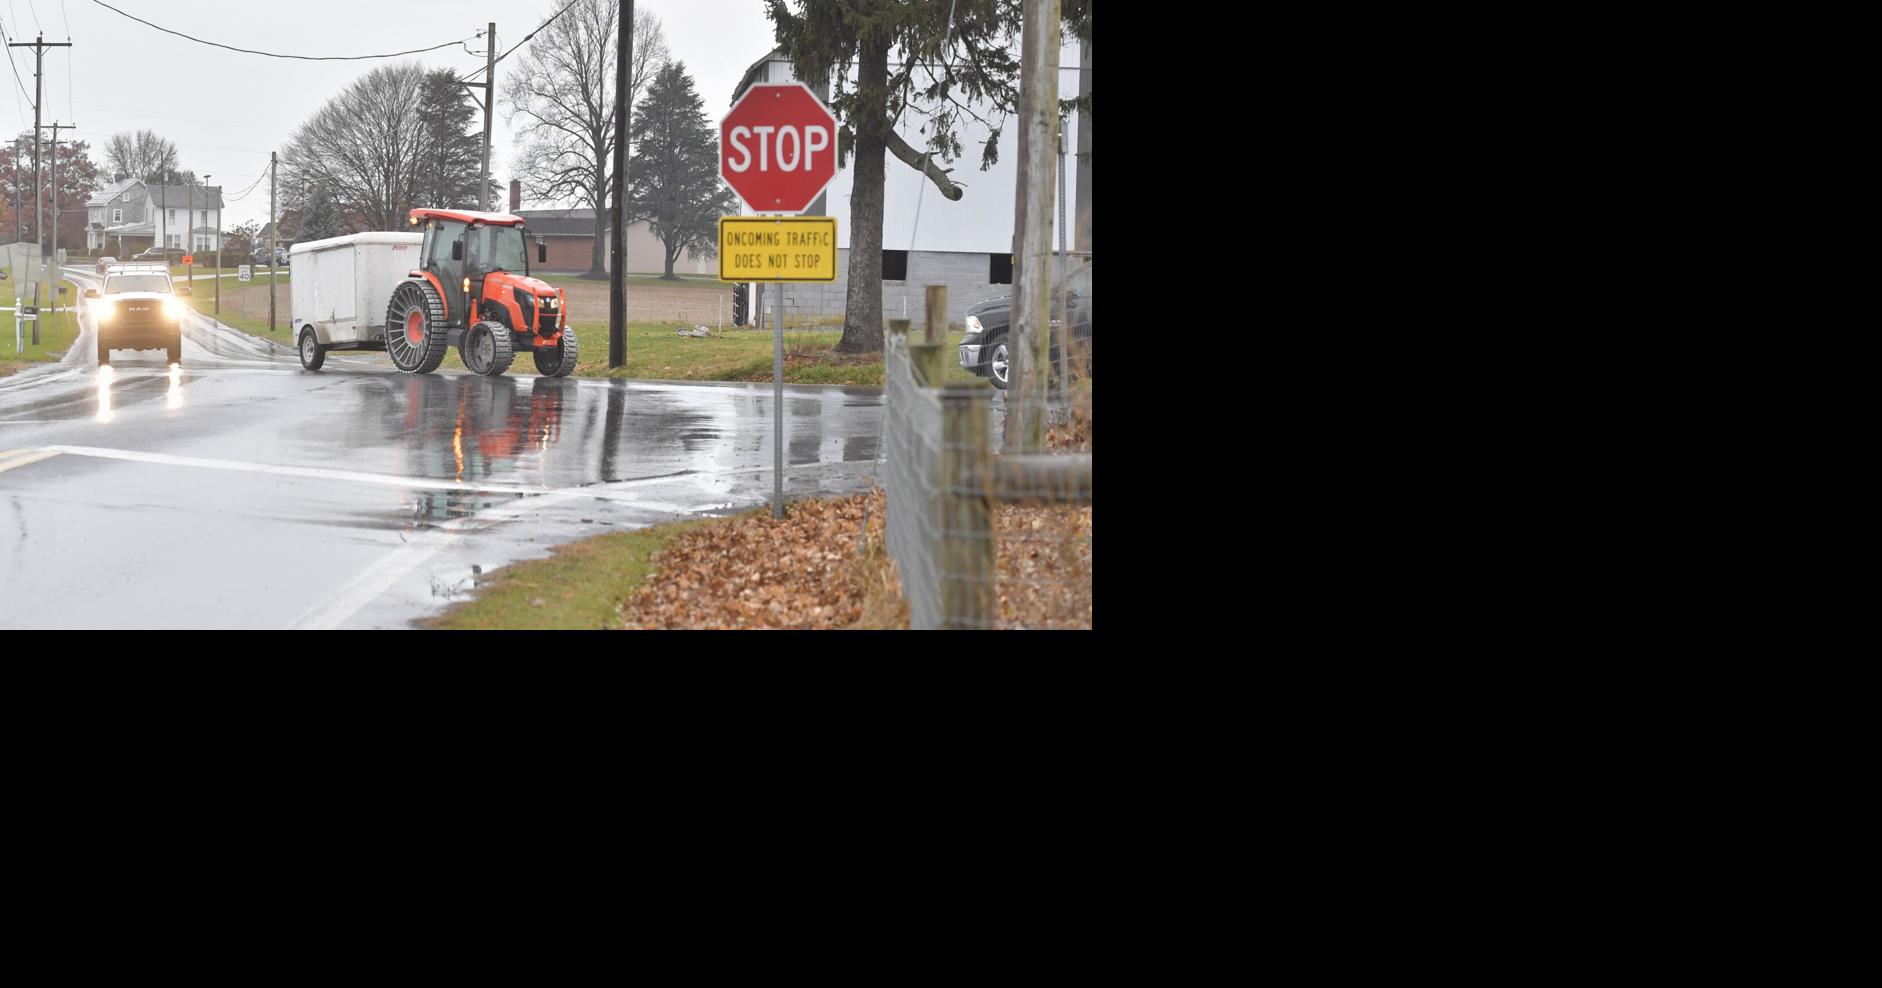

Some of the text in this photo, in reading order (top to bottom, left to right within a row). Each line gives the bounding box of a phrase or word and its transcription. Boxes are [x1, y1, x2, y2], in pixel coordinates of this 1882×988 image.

[728, 125, 829, 172] STOP
[727, 232, 829, 246] ONCOMING TRAFFIC
[735, 254, 821, 268] DOES NOT STOP
